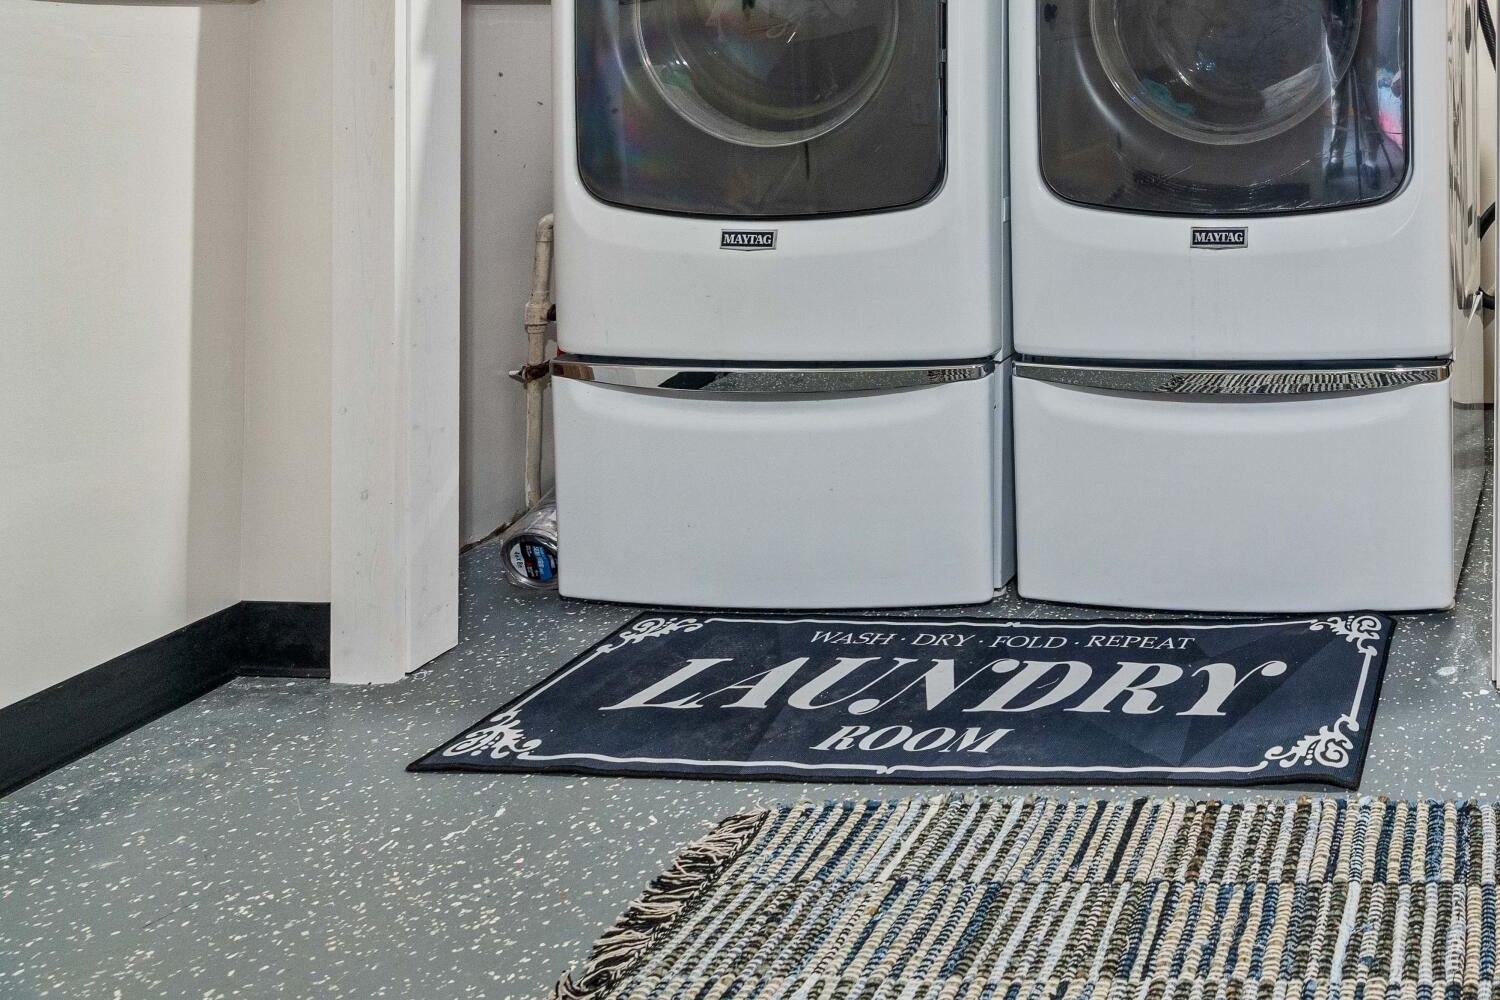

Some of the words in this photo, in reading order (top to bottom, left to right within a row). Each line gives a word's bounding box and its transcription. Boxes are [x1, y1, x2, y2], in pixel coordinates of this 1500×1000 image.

[723, 234, 772, 245] MAYTAG
[1194, 231, 1244, 243] MAYTAG
[809, 630, 898, 646] WASH
[911, 632, 977, 648] DRY
[988, 634, 1069, 650] FOLD
[1085, 635, 1196, 651] REPEAT
[600, 656, 1288, 716] LAUNDRY
[809, 725, 1015, 754] ROOM
